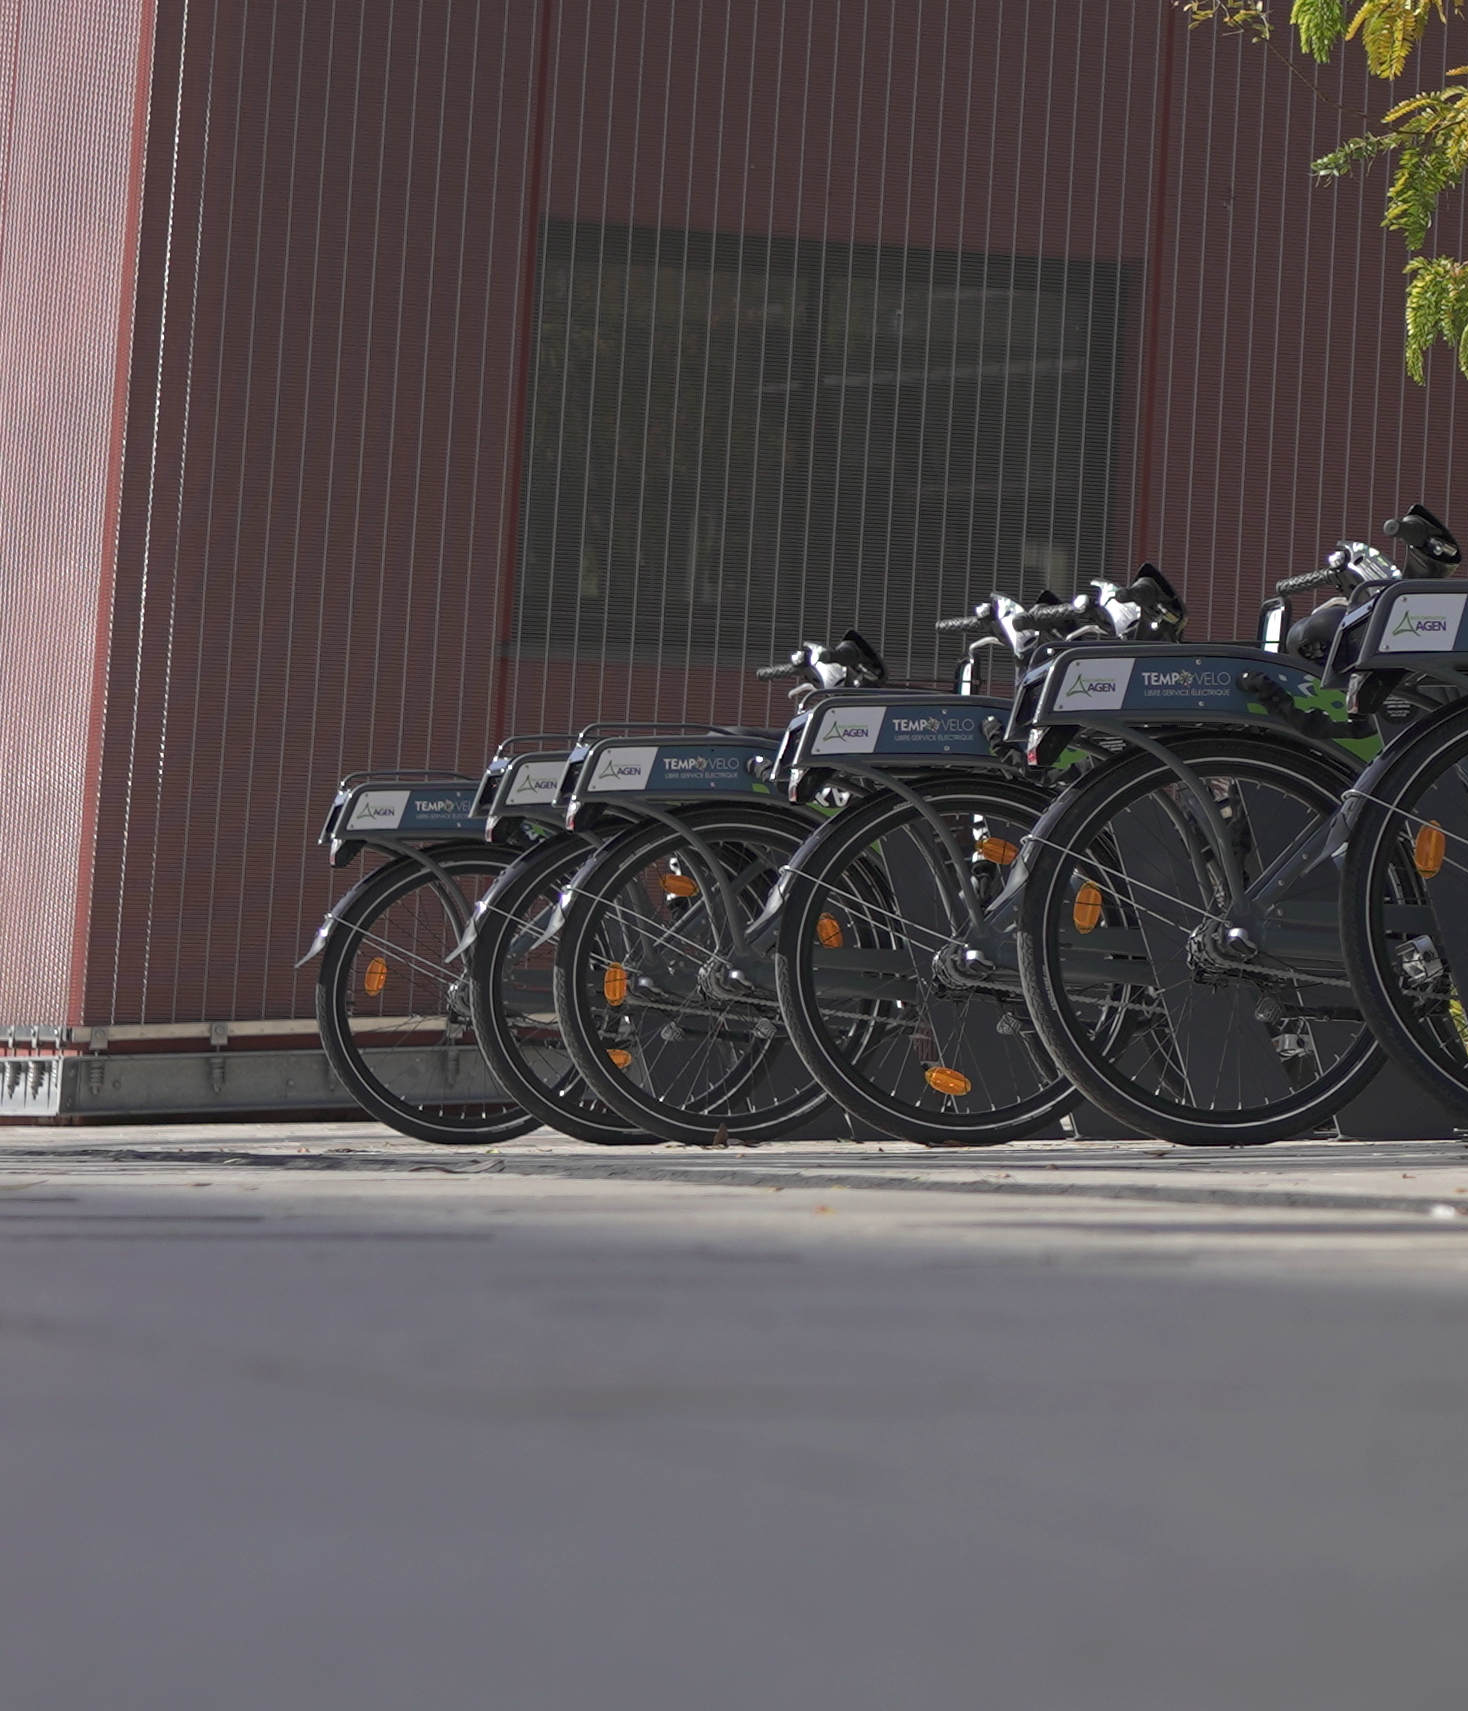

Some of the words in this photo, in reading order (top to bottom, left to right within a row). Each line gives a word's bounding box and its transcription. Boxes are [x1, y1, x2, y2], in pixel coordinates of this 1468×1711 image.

[1415, 621, 1446, 631] AGEN
[1194, 671, 1231, 686] VELO
[1087, 682, 1115, 692] AGEN
[940, 718, 975, 732] VELO
[842, 728, 869, 737] AGEN
[708, 757, 739, 770] VELO
[617, 767, 641, 776] AGEN
[534, 781, 557, 789] AGEN
[373, 808, 395, 816] AGEN
